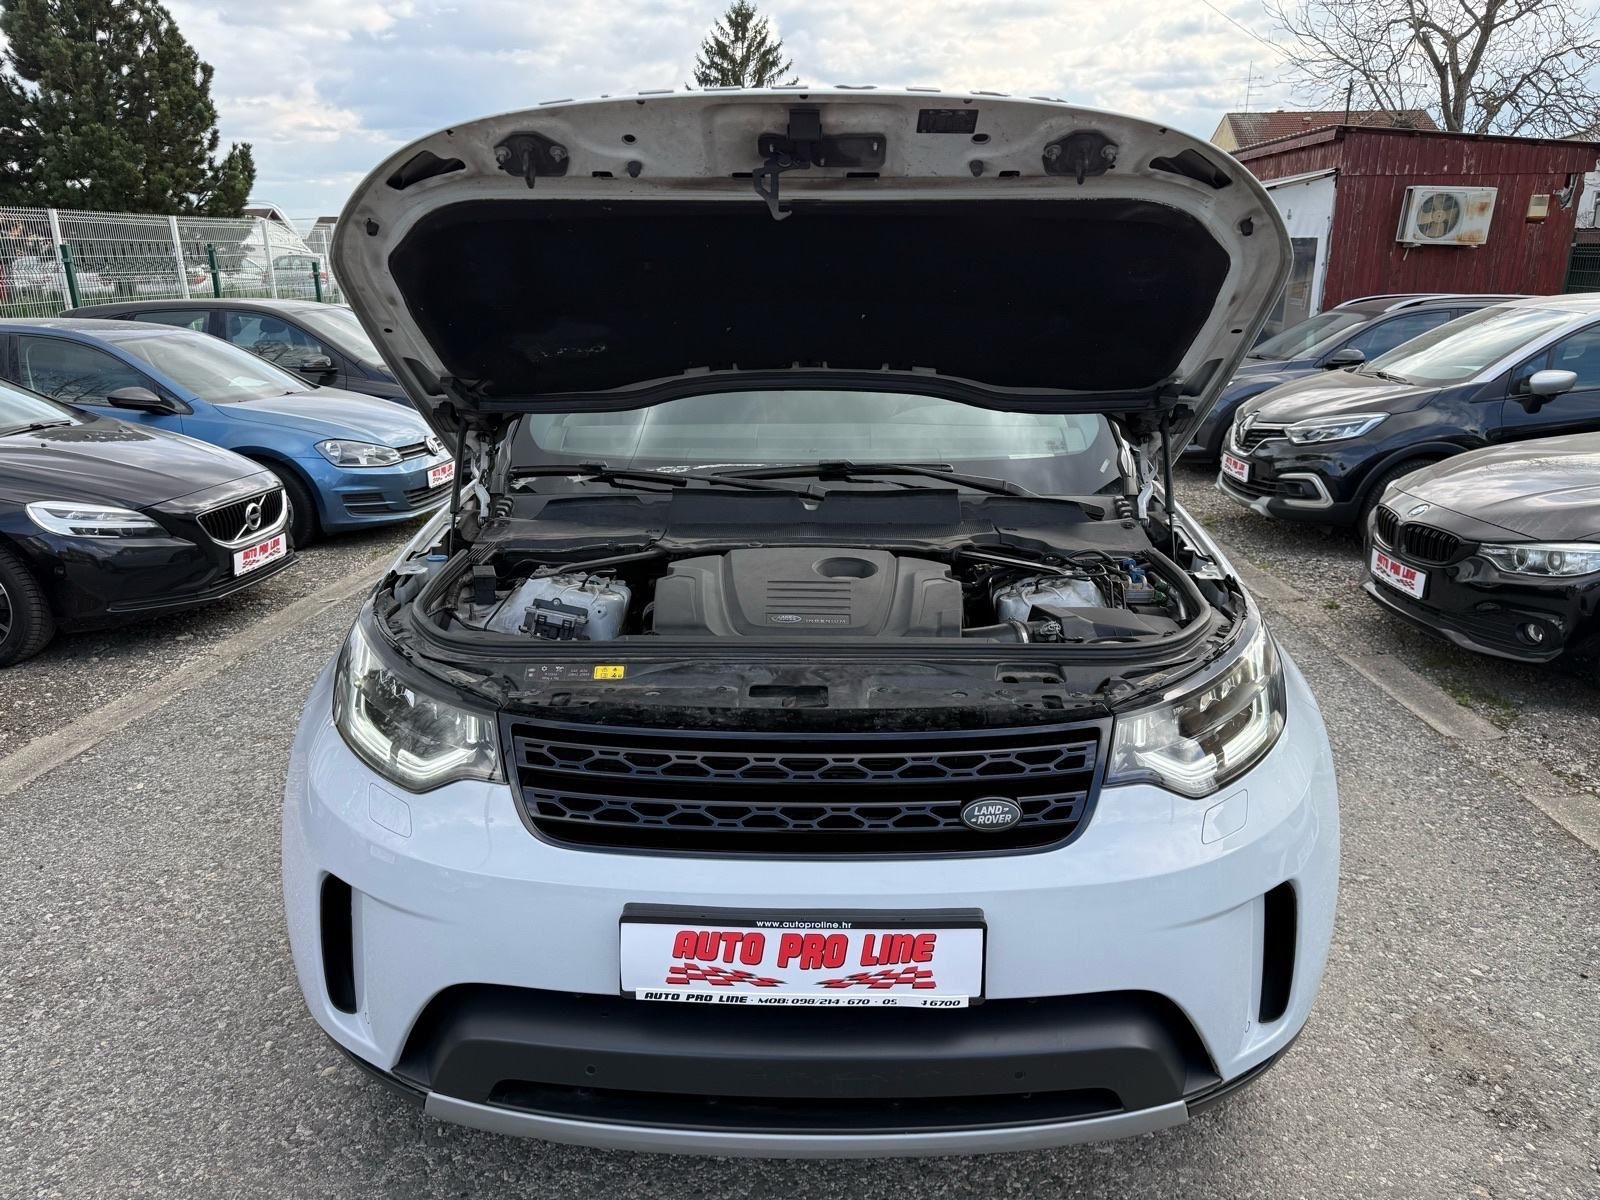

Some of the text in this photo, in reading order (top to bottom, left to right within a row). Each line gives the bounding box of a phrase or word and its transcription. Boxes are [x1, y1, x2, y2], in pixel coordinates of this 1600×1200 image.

[974, 805, 1003, 816] LAND
[977, 814, 1012, 825] ROVER
[756, 920, 852, 929] www.autoproline.hr
[672, 930, 937, 970] AUTO PRO LINE
[644, 992, 680, 1001] AUTO
[686, 993, 713, 1002] PRO
[718, 995, 748, 1003] LINE
